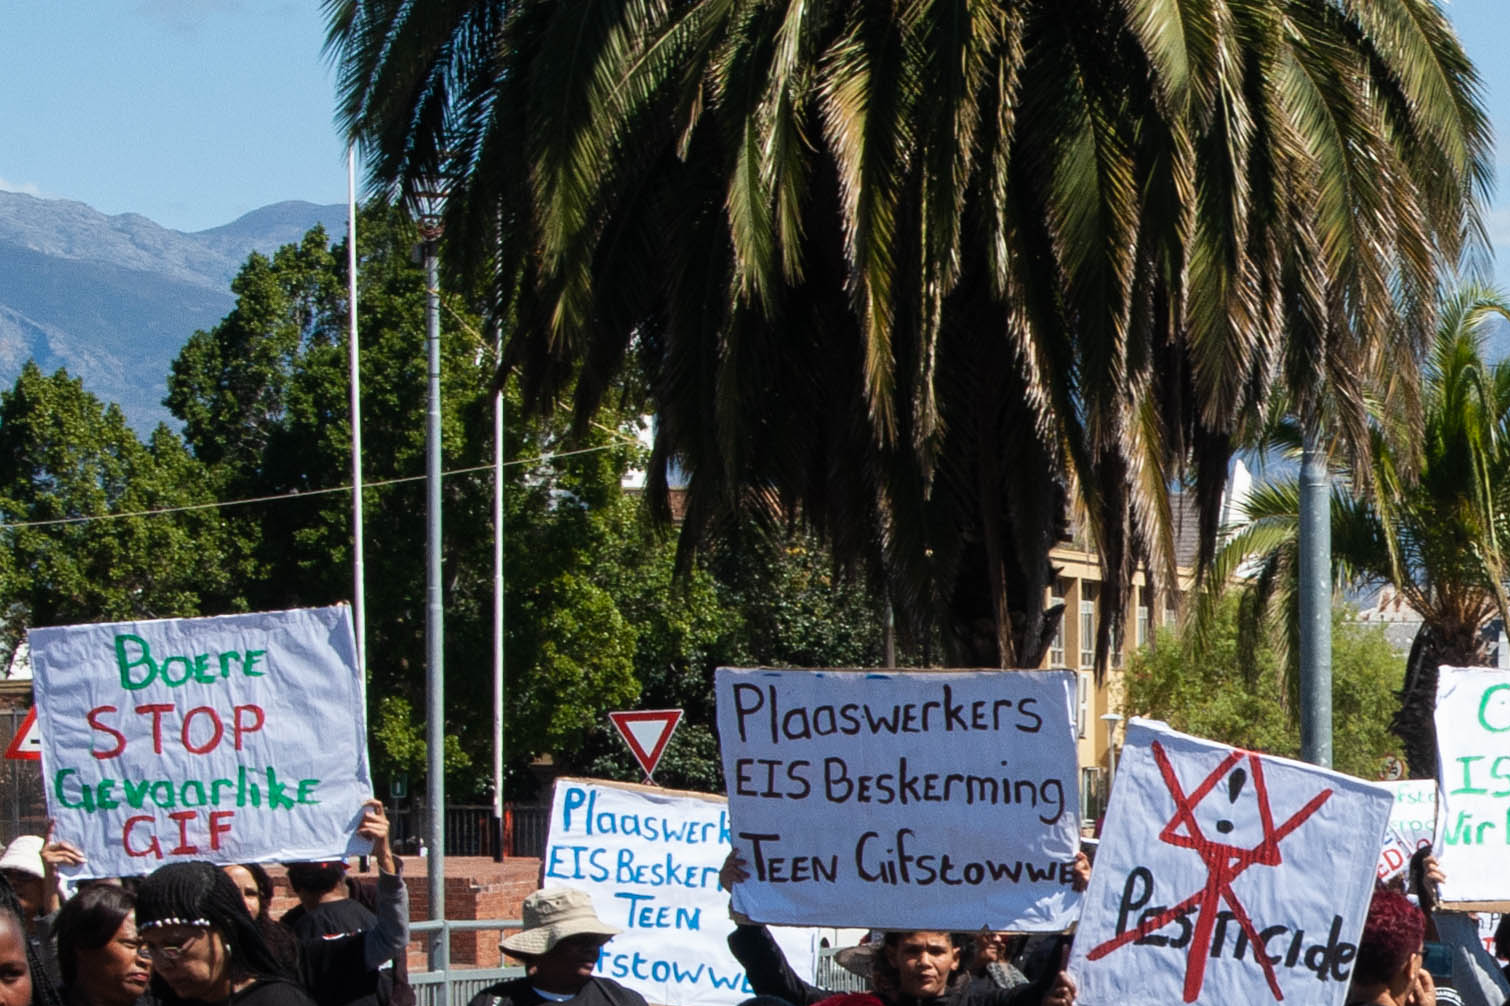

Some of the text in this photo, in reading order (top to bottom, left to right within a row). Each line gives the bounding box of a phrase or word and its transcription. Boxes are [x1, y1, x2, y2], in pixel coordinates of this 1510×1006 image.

[86, 703, 265, 760] STOP
[736, 758, 811, 800] EIS
[122, 810, 235, 860] GIF
[546, 845, 723, 892] EIS Besker
